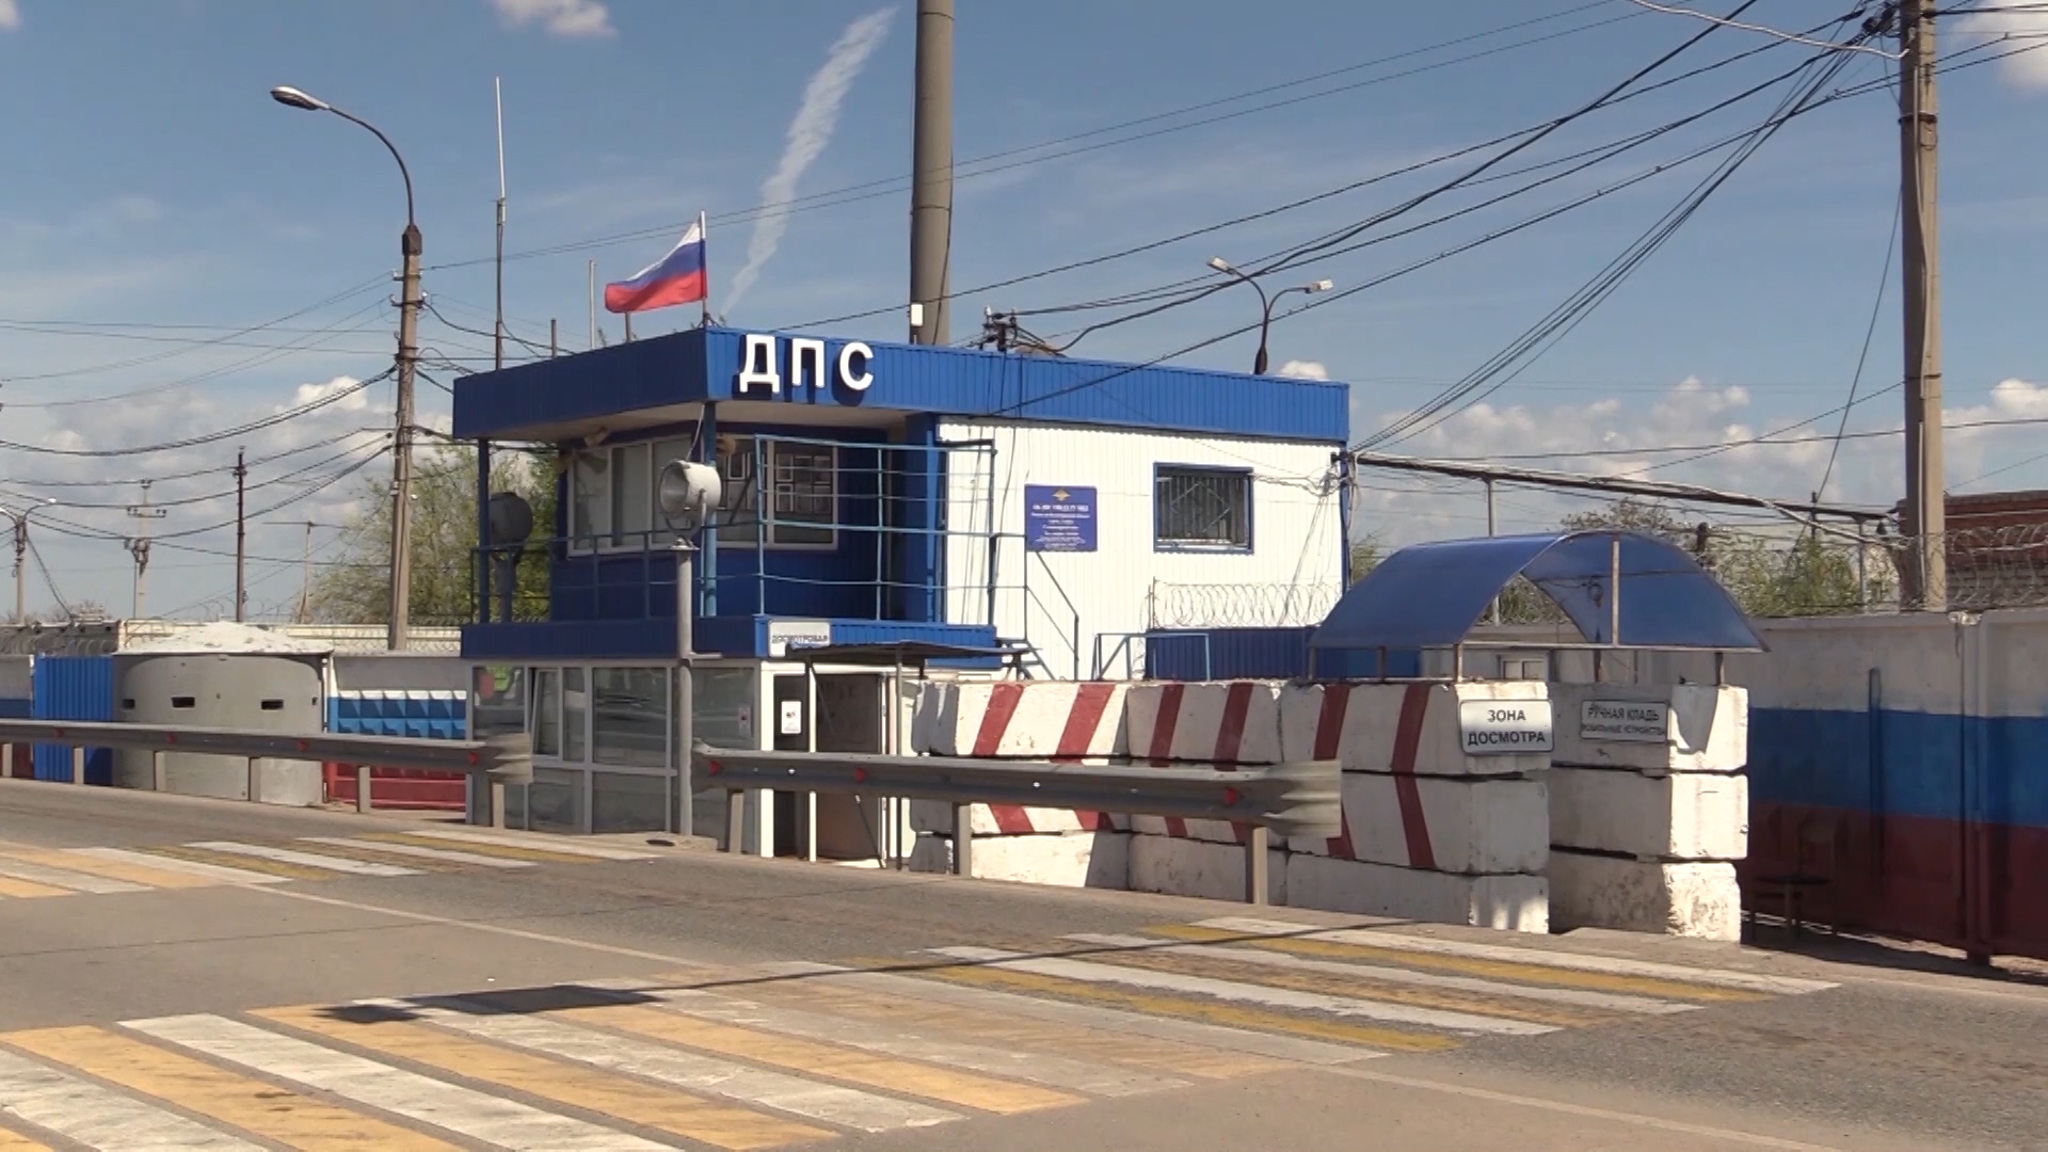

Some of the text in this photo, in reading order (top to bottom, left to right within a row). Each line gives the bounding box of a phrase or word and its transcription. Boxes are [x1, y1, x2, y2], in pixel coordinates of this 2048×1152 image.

[739, 333, 874, 393] ДПС
[1487, 709, 1526, 722] ЗОНА
[1467, 730, 1546, 747] ДОСМОТРА
